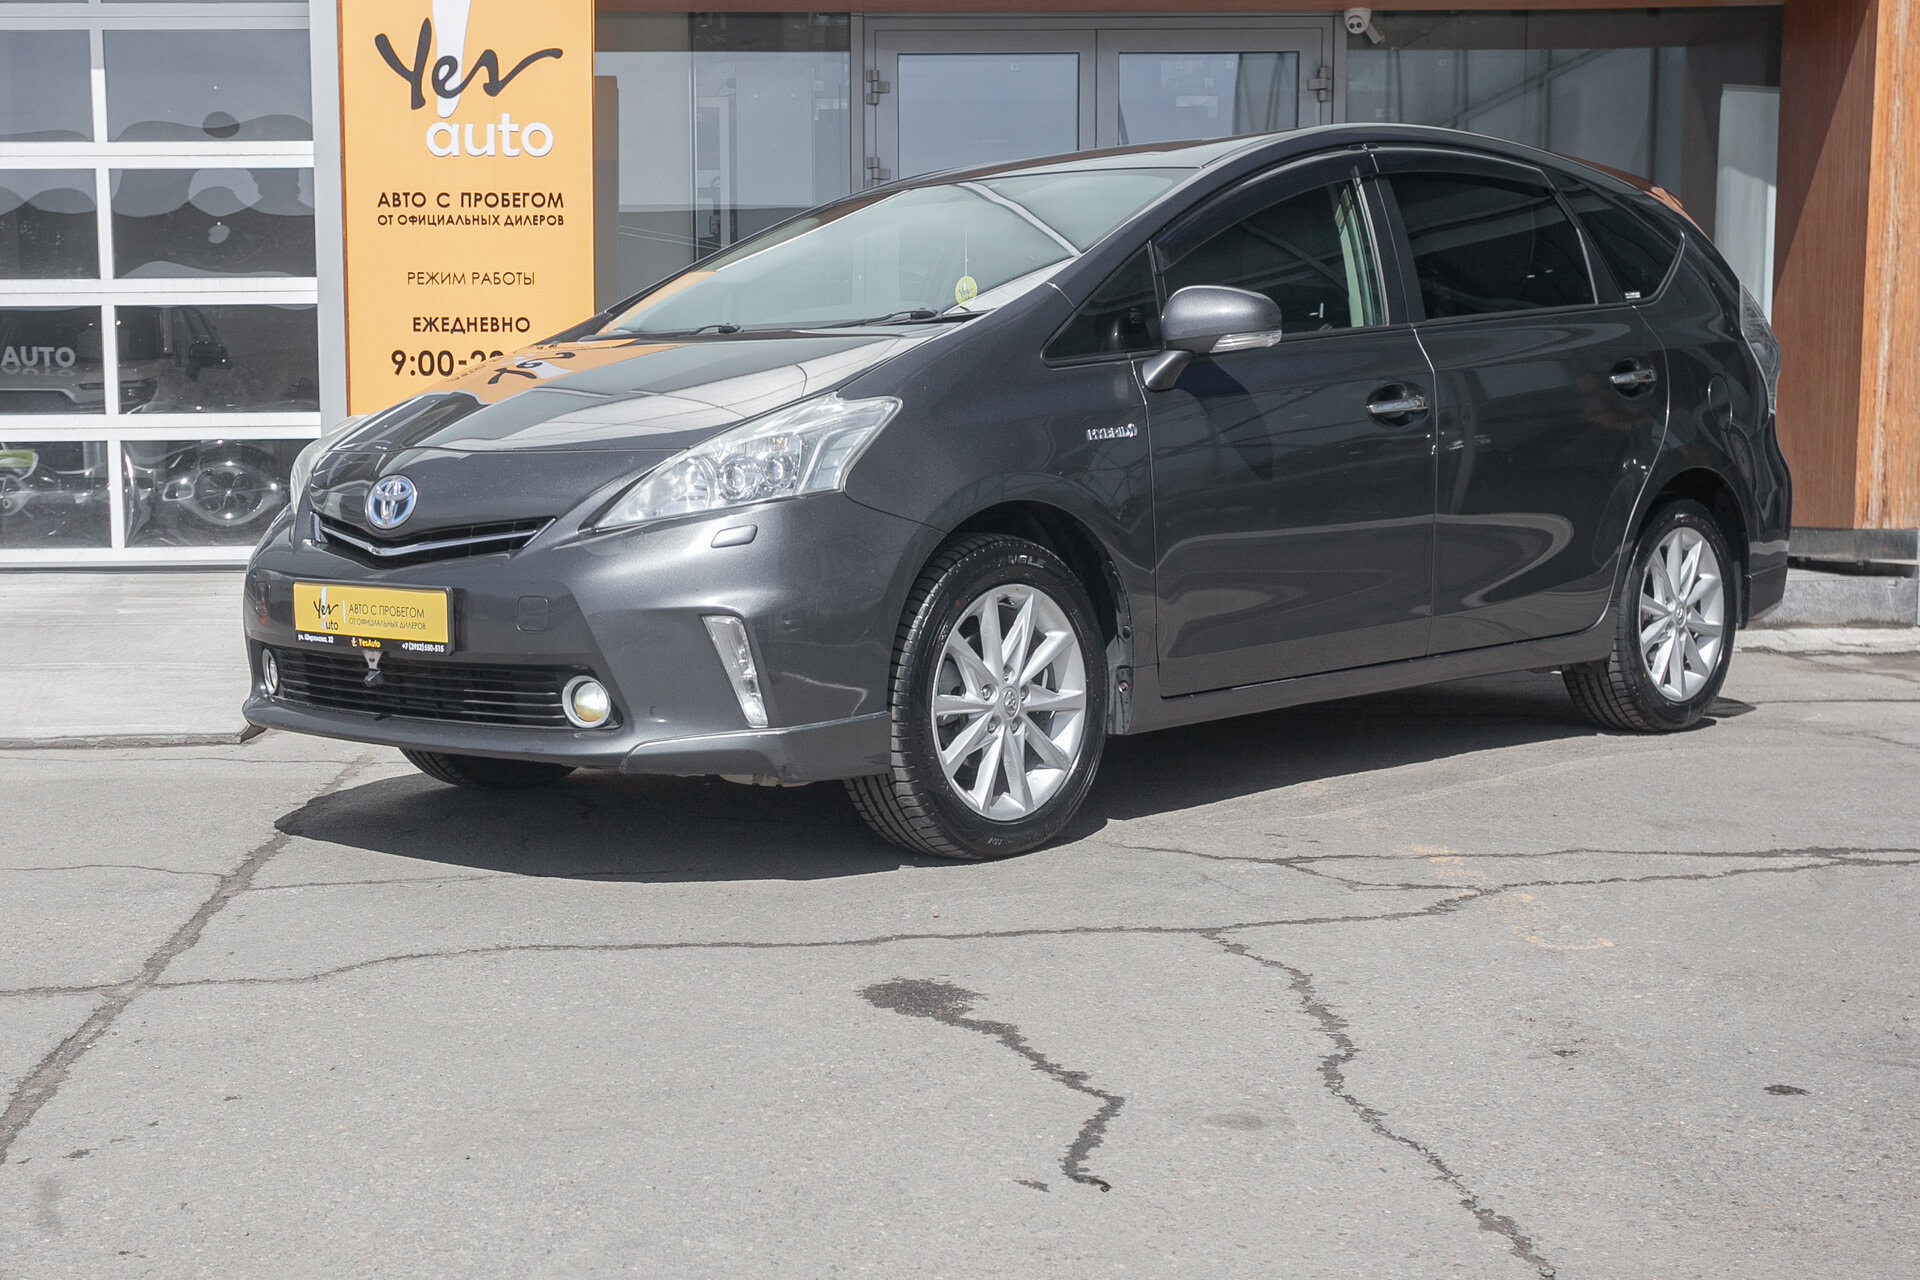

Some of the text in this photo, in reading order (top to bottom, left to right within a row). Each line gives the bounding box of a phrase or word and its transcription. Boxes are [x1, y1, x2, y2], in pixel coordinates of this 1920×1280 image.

[374, 17, 564, 110] Yes
[425, 112, 554, 157] auto
[377, 192, 564, 208] АВТО С ПРОБЕГОМ
[377, 214, 564, 227] ОТ ОФИЦИАЛЬНЫХ ДИЛЕРОВ
[407, 272, 535, 285] РЕЖИМ РАБОТЫ
[412, 317, 530, 334] ЕЖЕДНЕВНО
[1, 346, 76, 368] AUTO
[391, 350, 505, 377] 9:00-
[348, 603, 425, 619] АВТО С ПРОБЕГОМ
[348, 617, 426, 630] ОТ ОФИЦИАЛЬНЫХ ДИЛЕРОВ
